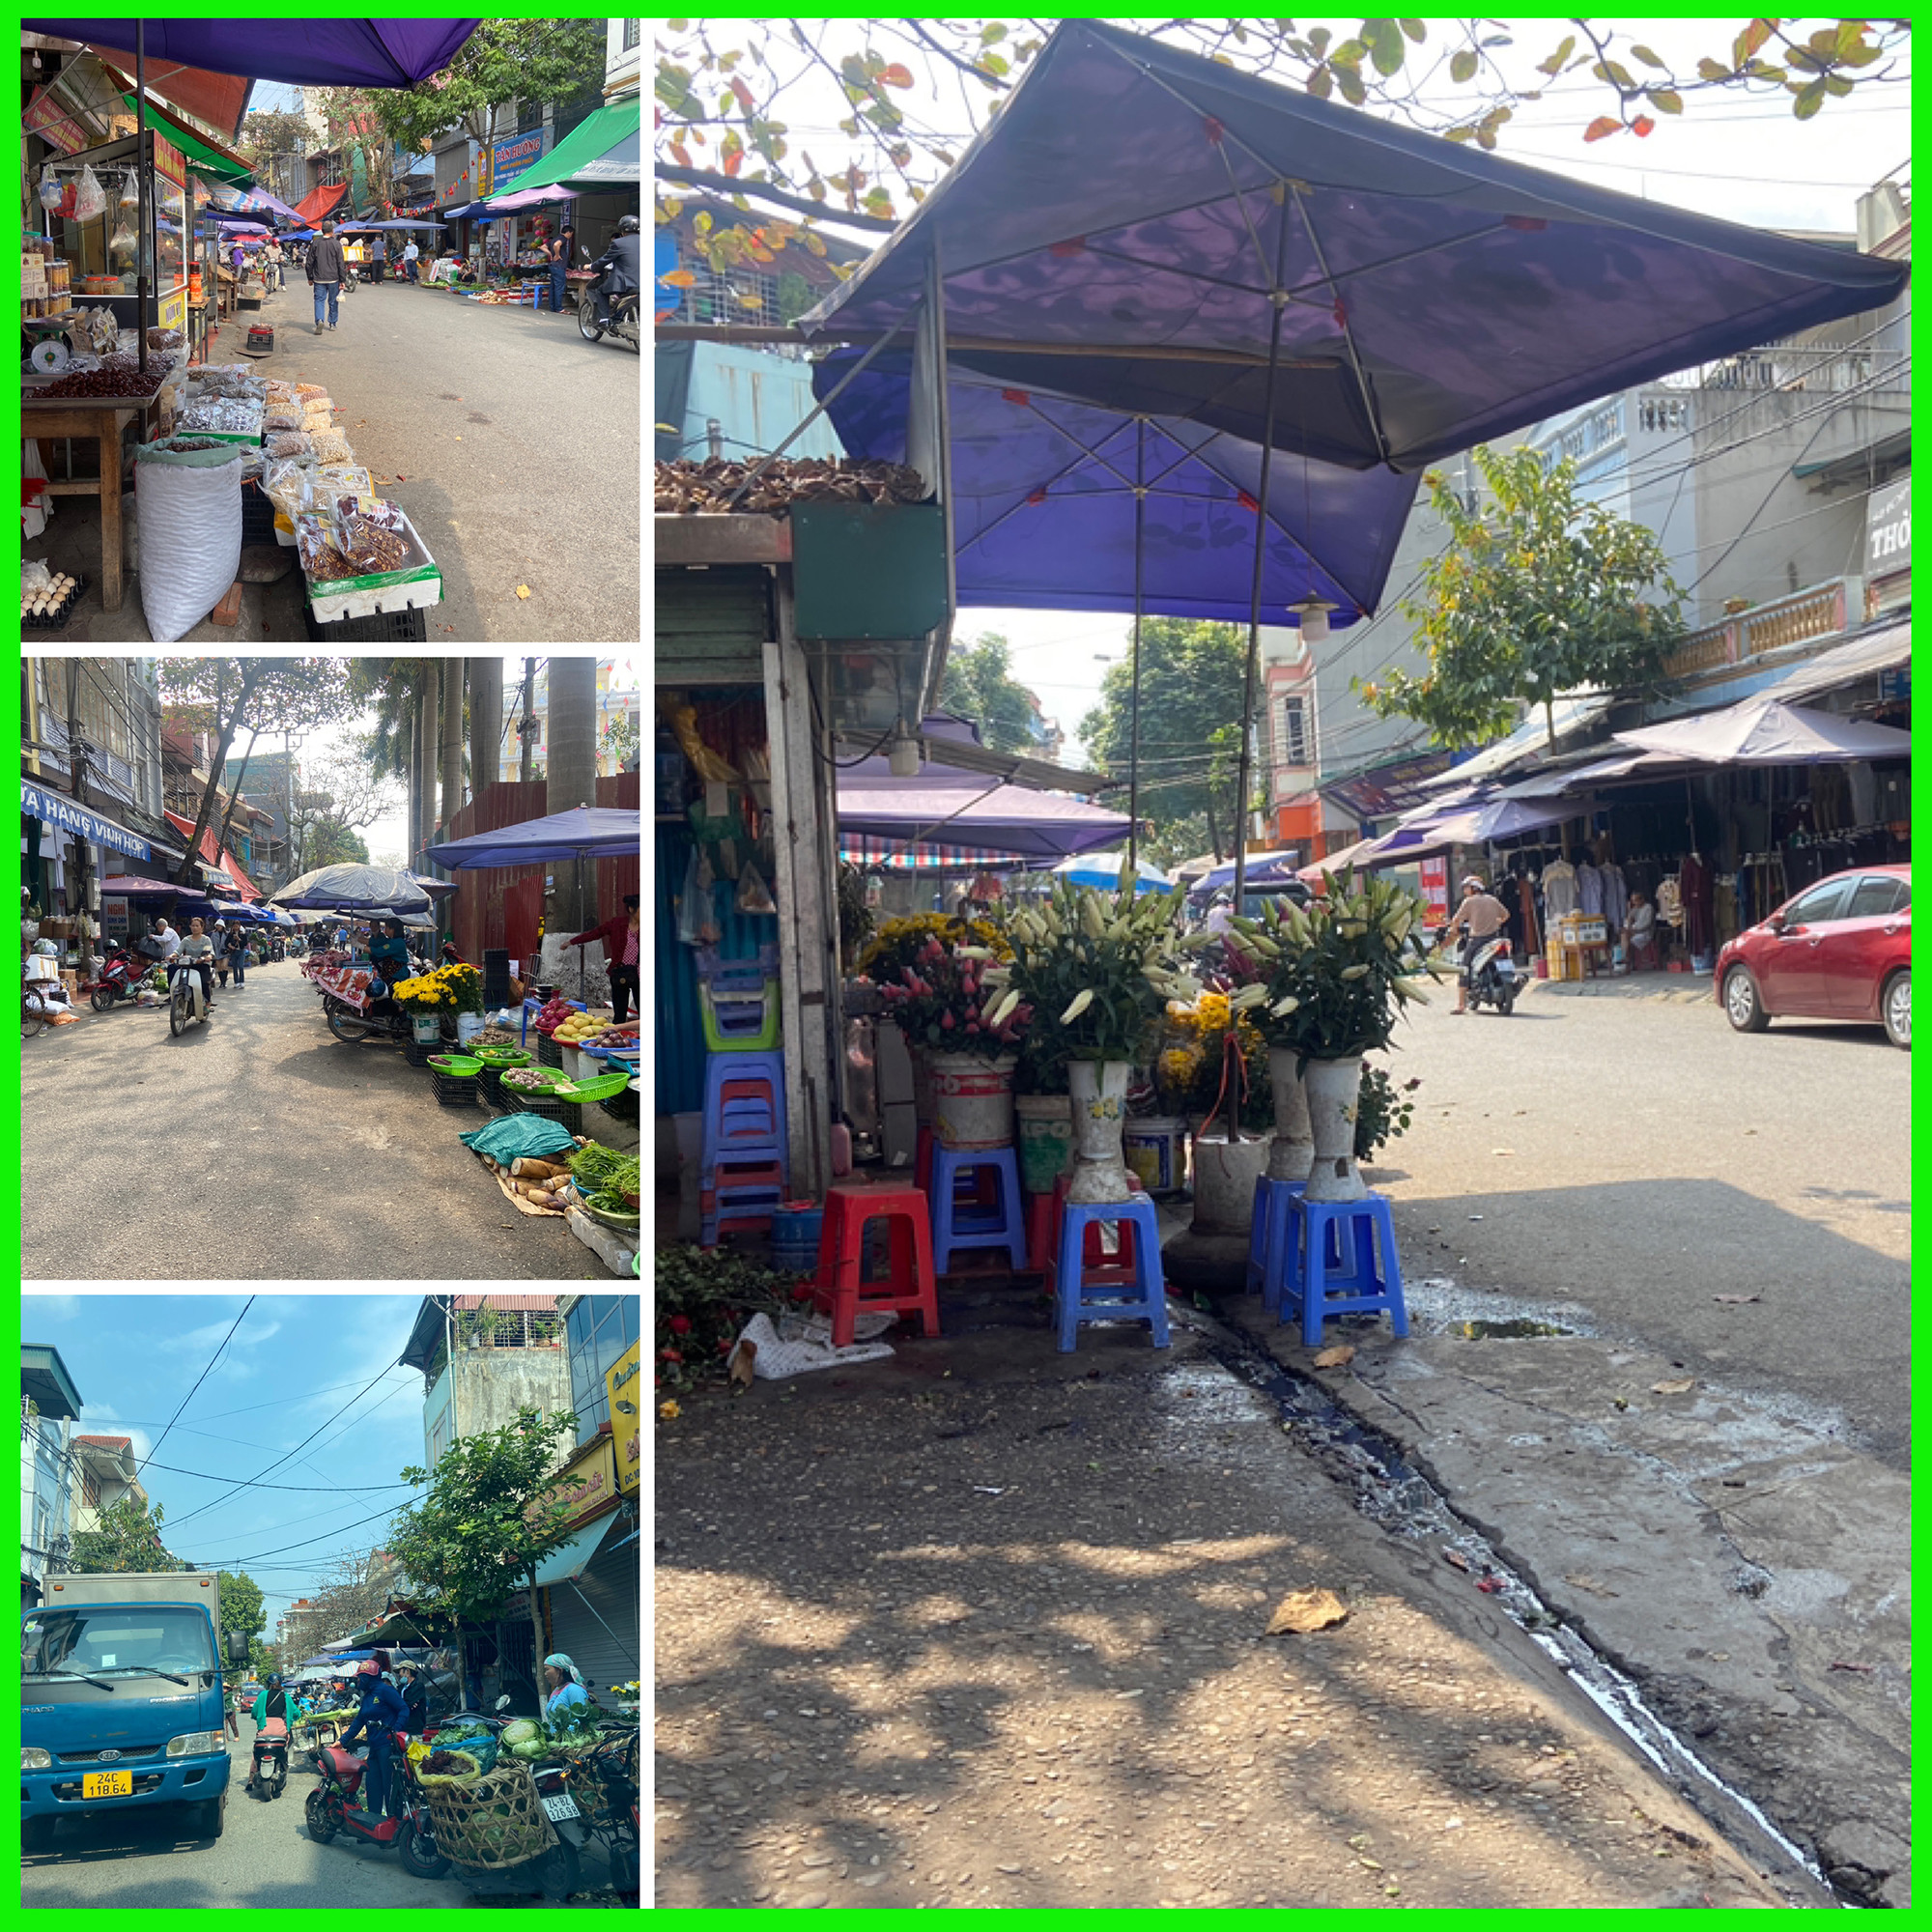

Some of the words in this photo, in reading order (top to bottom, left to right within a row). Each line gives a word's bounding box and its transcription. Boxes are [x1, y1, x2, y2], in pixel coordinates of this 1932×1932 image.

[45, 799, 91, 833] HÀNG
[101, 1752, 118, 1761] KIA
[97, 1774, 119, 1784] 24C
[90, 1783, 127, 1797] 118.64
[549, 1805, 579, 1820] 326.98
